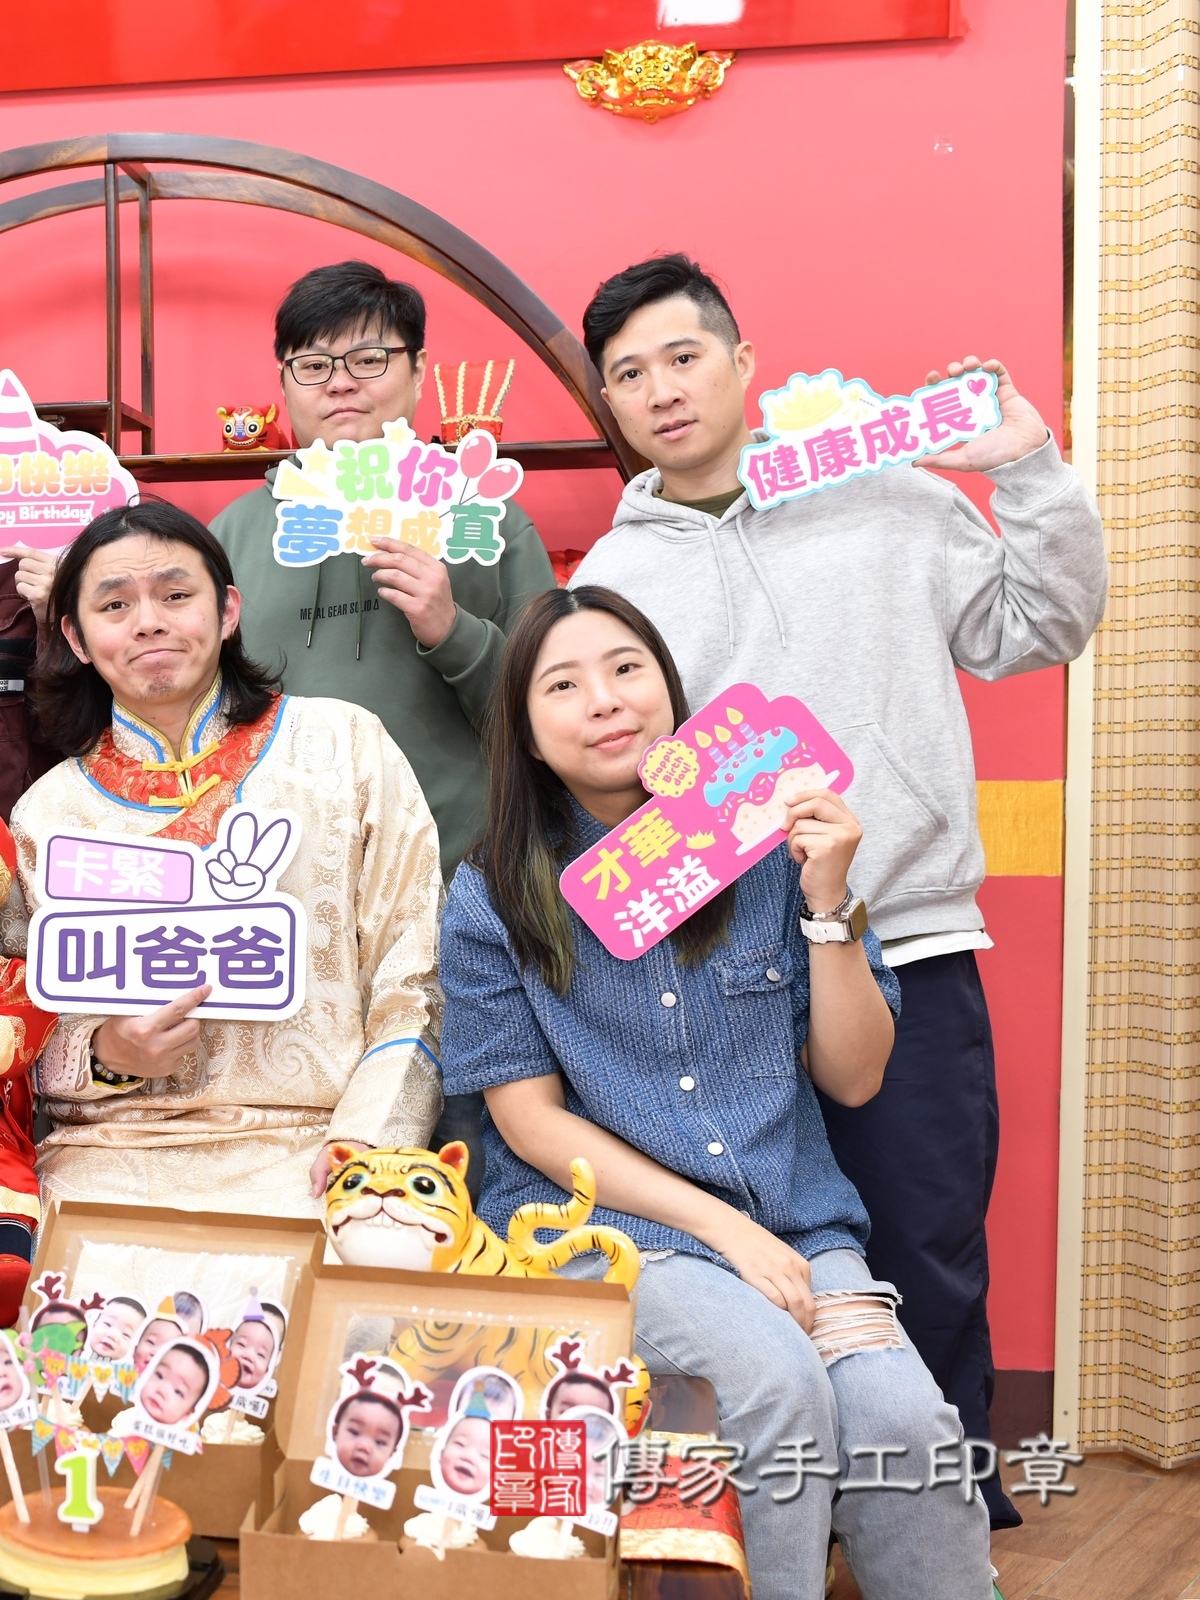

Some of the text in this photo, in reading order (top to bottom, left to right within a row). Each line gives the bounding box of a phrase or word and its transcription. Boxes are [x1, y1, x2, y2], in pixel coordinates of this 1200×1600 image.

[747, 387, 977, 501] 健康成長
[336, 444, 458, 506] 祝你
[19, 506, 91, 523] Birthday
[277, 502, 501, 562] 夢想成真
[300, 607, 325, 620] MEAL
[328, 603, 347, 618] GEAR
[649, 748, 676, 781] Happy
[662, 756, 684, 783] Birth
[674, 762, 691, 786] day!
[56, 846, 165, 897] 卡緊
[581, 807, 683, 900] 才華
[614, 854, 721, 947] 洋溢
[58, 925, 285, 990] 叫爸爸
